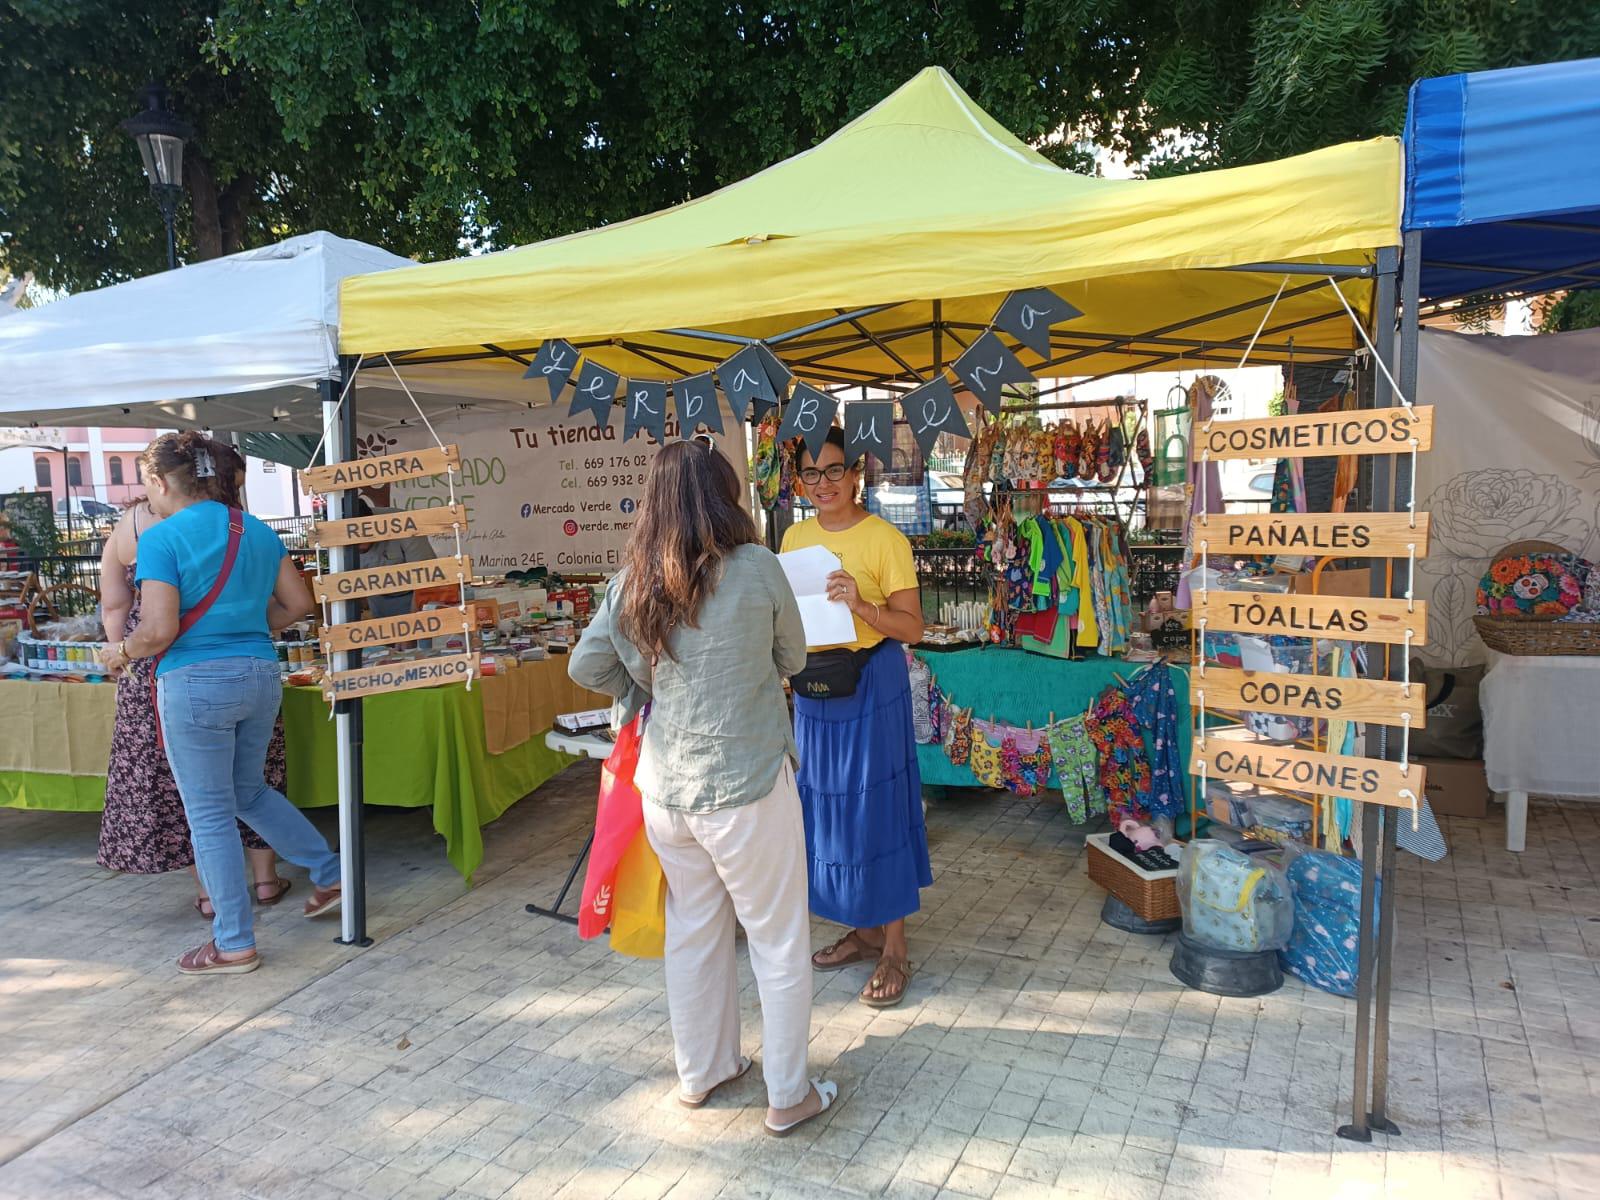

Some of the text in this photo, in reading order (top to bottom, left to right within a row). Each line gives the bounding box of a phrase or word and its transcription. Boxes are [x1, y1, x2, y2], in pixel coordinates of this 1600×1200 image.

[510, 428, 539, 449] Tu
[547, 424, 616, 446] tienda
[1208, 417, 1411, 453] COSMETICOS
[333, 457, 424, 485] AHORRA
[559, 459, 579, 471] Tel.
[584, 457, 604, 469] 669
[608, 456, 630, 468] 176
[633, 455, 647, 466] 02
[561, 477, 582, 489] Cel.
[587, 476, 608, 488] 669
[612, 474, 633, 486] 932
[532, 503, 575, 515] Mercado
[580, 500, 612, 513] Verde
[346, 516, 418, 539] REUSA
[579, 519, 635, 532] verde.mer
[1229, 520, 1371, 548] PAÑALES
[479, 554, 517, 568] Marina
[556, 551, 602, 566] Colonia
[607, 550, 619, 564] El
[337, 565, 446, 594] GARANTIA
[349, 616, 442, 644] CALIDAD
[1228, 603, 1369, 632] TOALLAS
[333, 672, 393, 693] HECHO
[405, 660, 467, 682] MEXICO
[1240, 681, 1343, 710] COPAS
[1214, 750, 1380, 794] CALZONES
